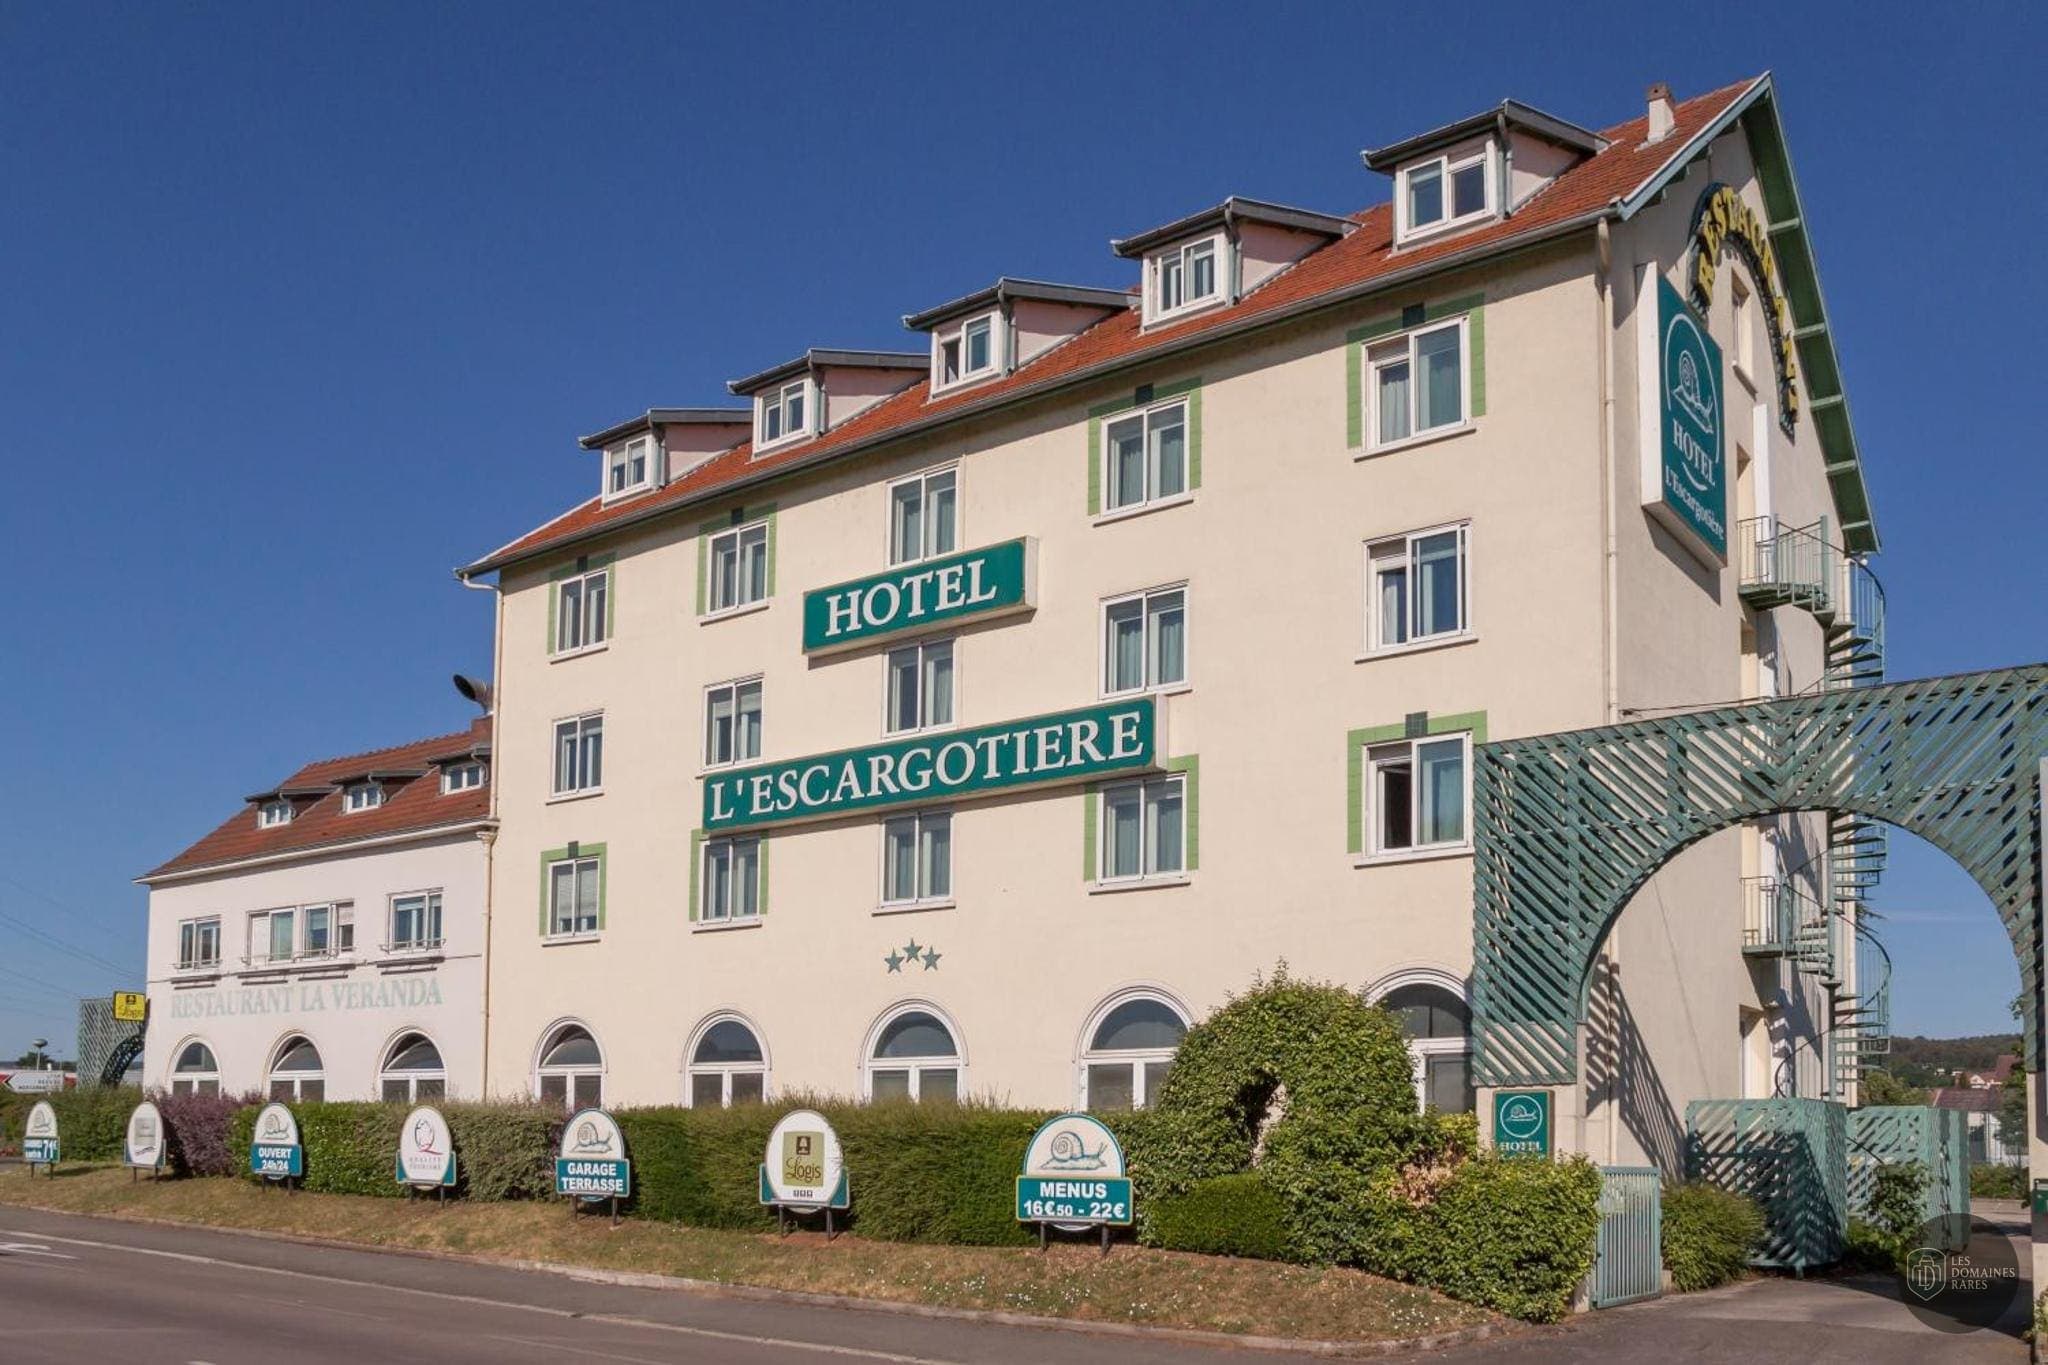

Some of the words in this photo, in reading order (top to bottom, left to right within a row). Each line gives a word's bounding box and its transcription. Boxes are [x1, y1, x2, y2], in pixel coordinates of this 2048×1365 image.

[1673, 418, 1716, 487] HOTEL
[824, 558, 998, 637] HOTEL
[710, 710, 1145, 822] L'ESCARGOTIERE
[170, 985, 297, 1019] RESTAURANT
[300, 985, 329, 1013] LA
[331, 977, 445, 1011] VERANDA
[258, 1147, 292, 1159] OUVERT
[1499, 1141, 1543, 1152] HOTEL
[567, 1162, 617, 1176] GARAGE
[784, 1156, 822, 1183] Logis
[561, 1177, 624, 1192] TERRASSE
[1039, 1182, 1108, 1199] MENUS
[1089, 1202, 1126, 1218] 22€
